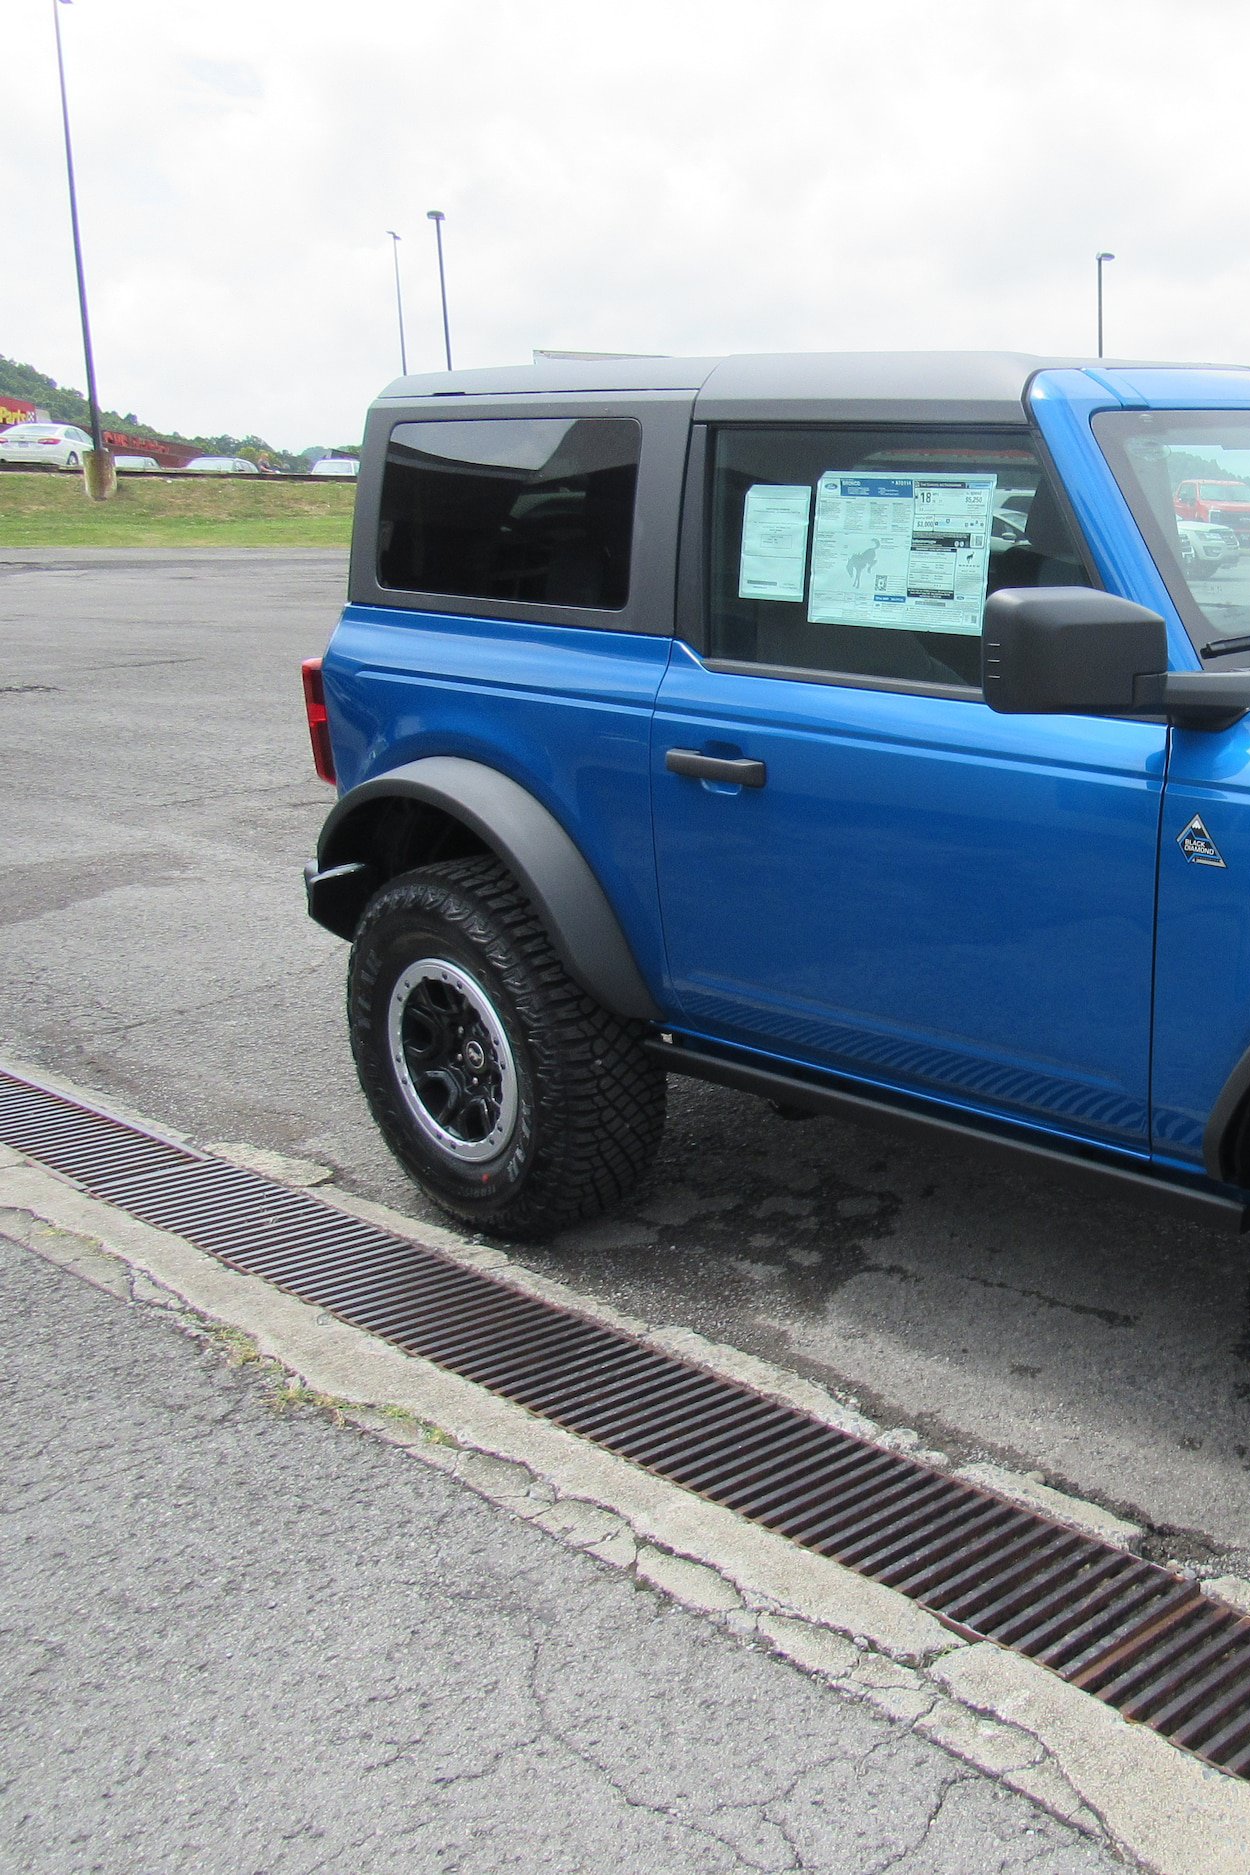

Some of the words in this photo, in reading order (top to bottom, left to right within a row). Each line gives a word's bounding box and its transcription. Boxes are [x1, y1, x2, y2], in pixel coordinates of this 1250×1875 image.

[920, 492, 932, 503] 18
[1185, 839, 1206, 848] BLACK
[1184, 845, 1215, 856] DIAMOND
